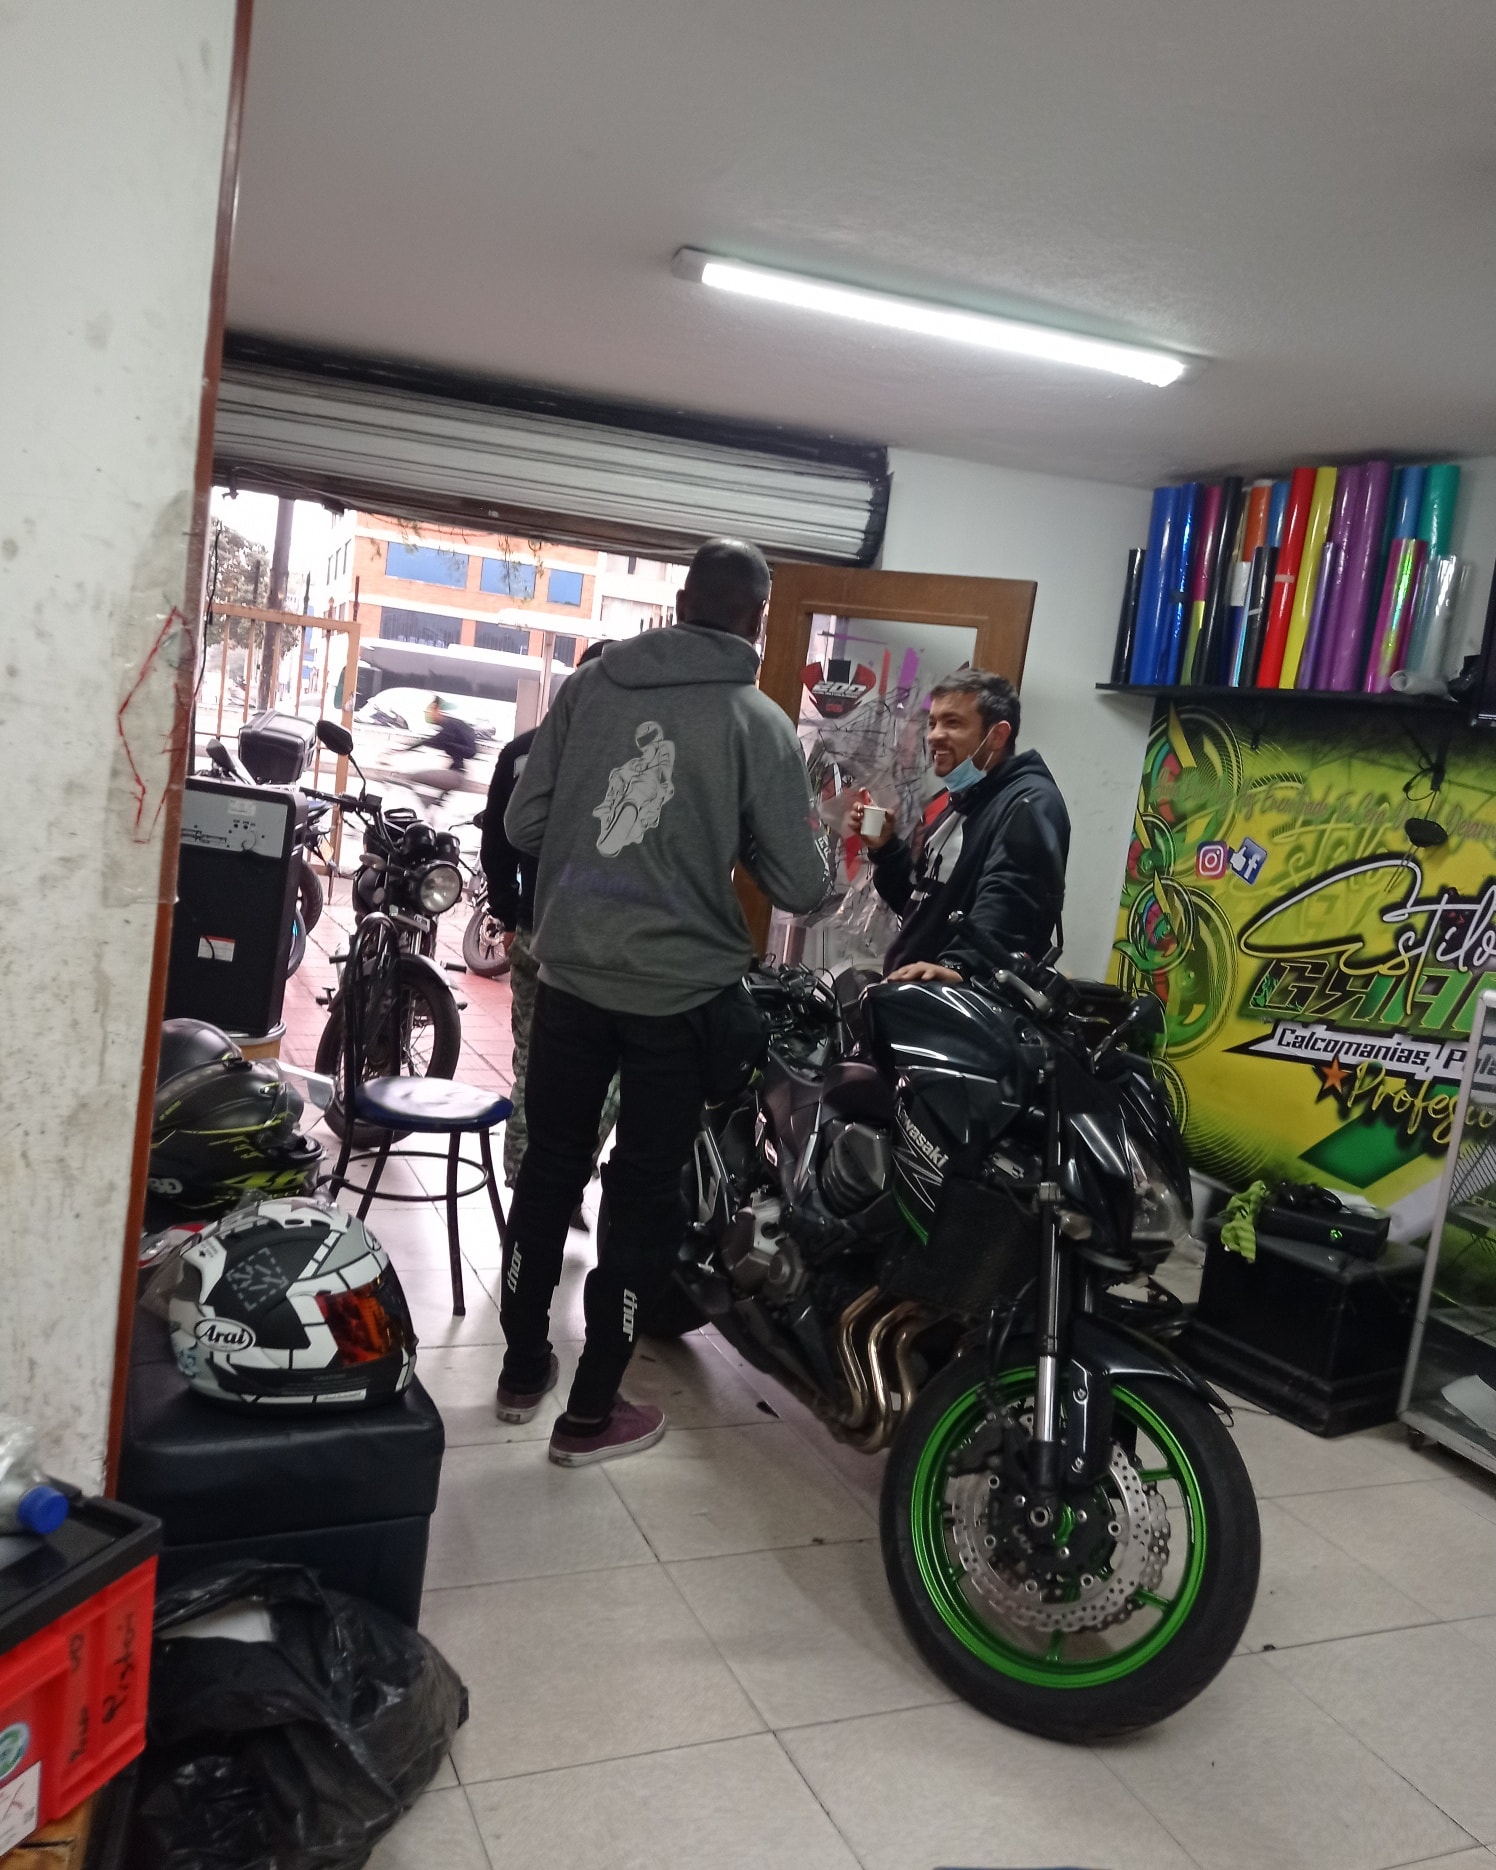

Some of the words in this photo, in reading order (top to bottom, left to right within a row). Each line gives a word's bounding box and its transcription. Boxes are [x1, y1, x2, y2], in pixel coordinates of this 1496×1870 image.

[507, 1241, 522, 1294] thor
[200, 1323, 247, 1345] Arai
[623, 1288, 638, 1343] thor
